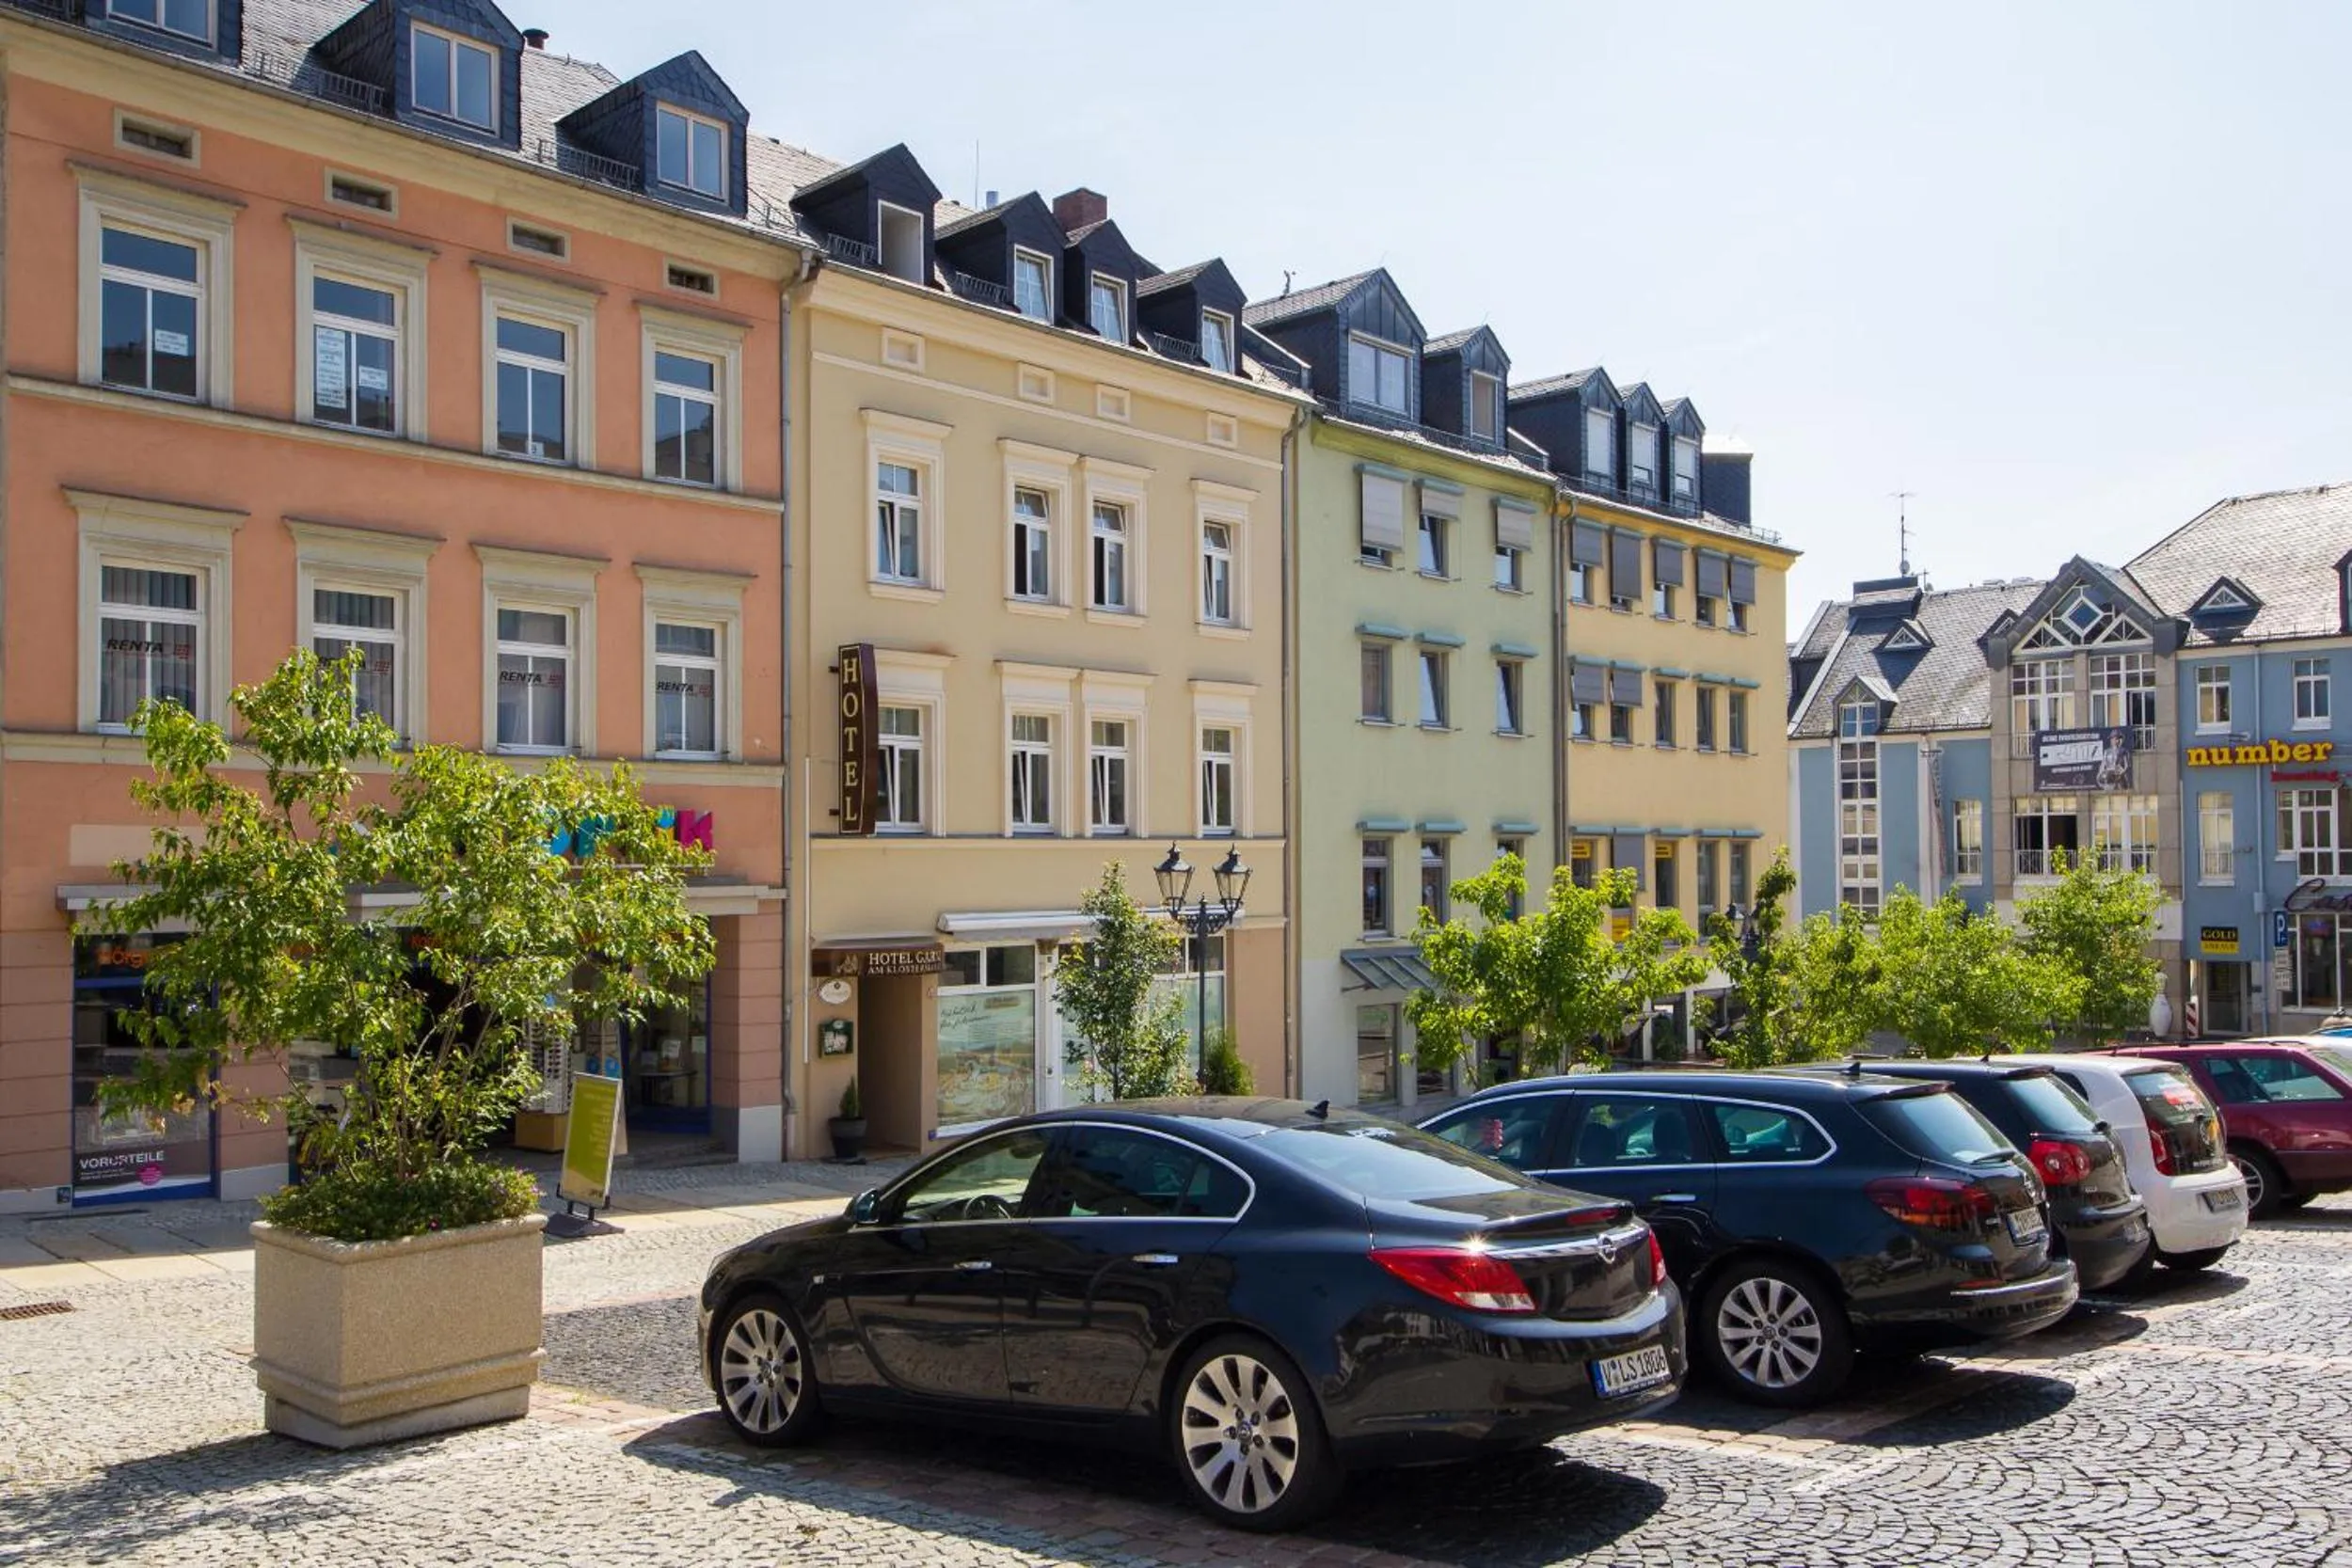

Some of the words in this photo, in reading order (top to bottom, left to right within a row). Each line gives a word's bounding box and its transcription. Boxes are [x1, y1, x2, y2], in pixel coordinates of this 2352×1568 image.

[107, 639, 163, 653] RENTA
[500, 671, 542, 684] RENTA
[656, 681, 693, 692] RENTA
[843, 658, 858, 821] HOTEL
[2186, 737, 2333, 767] number
[2202, 929, 2235, 940] GOLD
[869, 952, 913, 965] HOTEL
[867, 965, 883, 975] AM
[1602, 1361, 1612, 1386] V
[1618, 1355, 1638, 1382] LS
